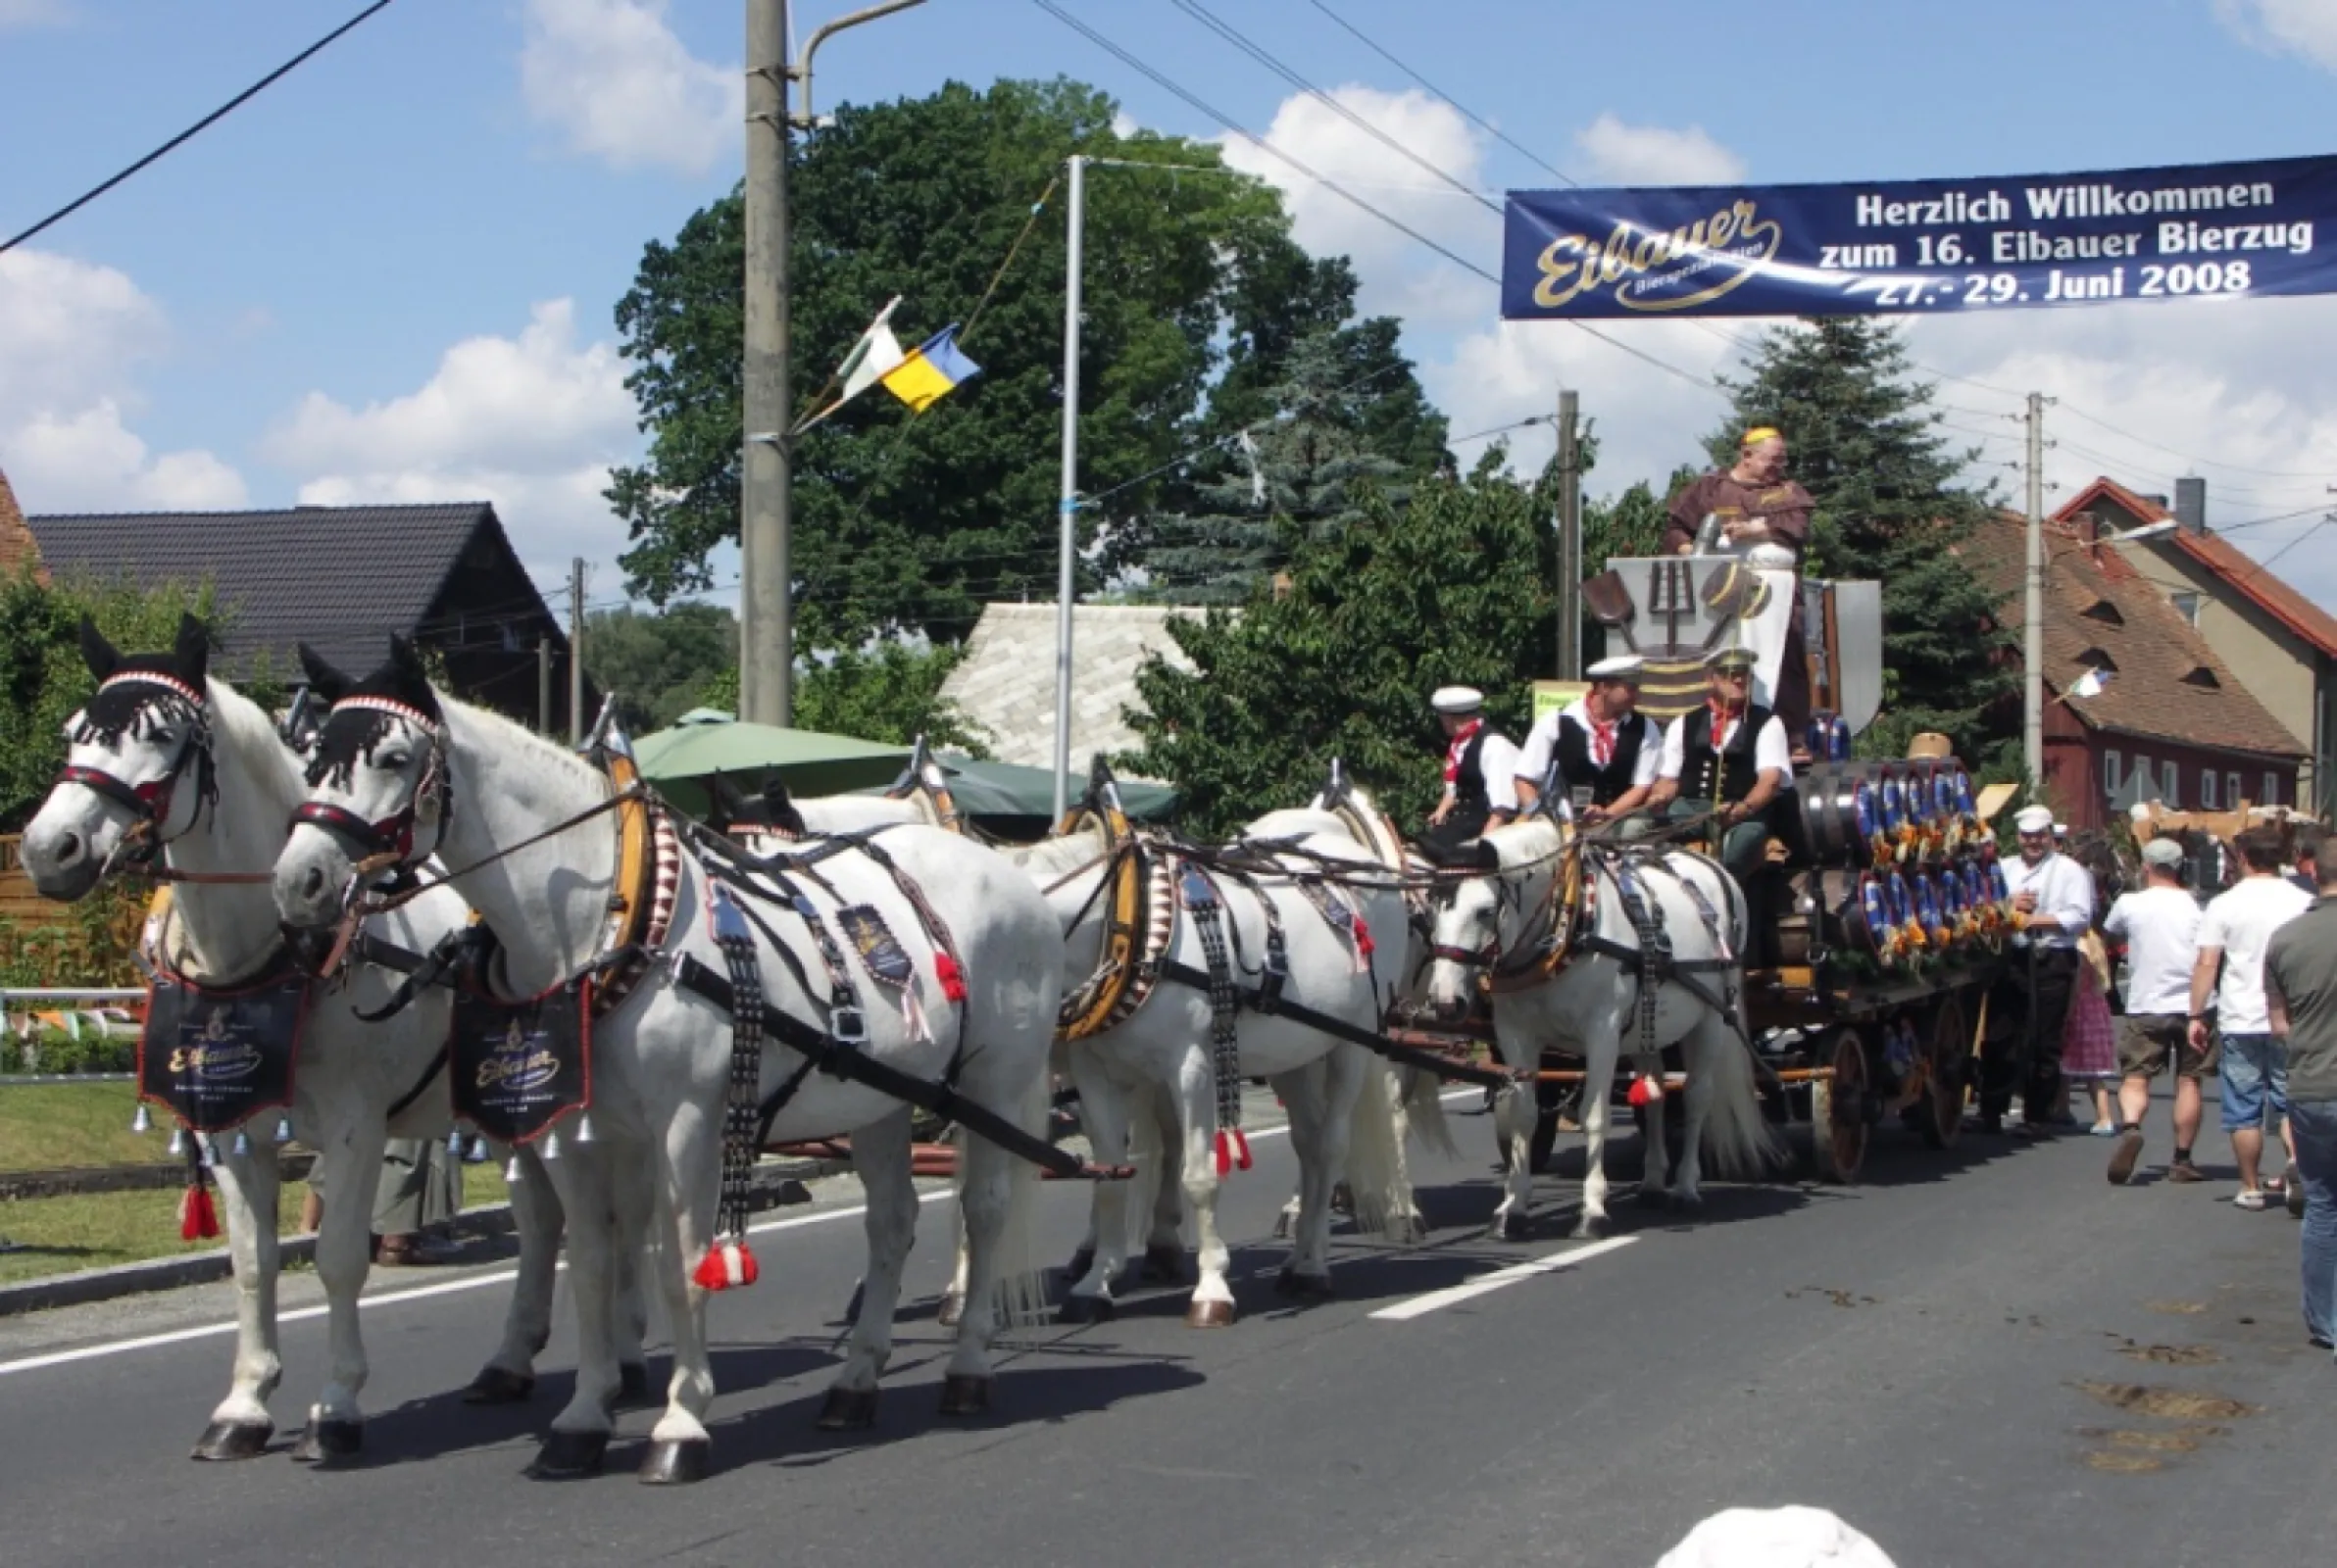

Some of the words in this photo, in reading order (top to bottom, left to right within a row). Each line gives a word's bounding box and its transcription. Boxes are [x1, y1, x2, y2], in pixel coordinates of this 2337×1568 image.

[1856, 190, 2011, 226] Herzlich
[2025, 181, 2275, 220] Willkommen
[1534, 199, 1772, 309] Eibauer
[1819, 243, 1897, 268] zum
[1916, 233, 1976, 267] 16.
[1991, 230, 2142, 264] Eibauer
[2158, 220, 2313, 255] Bierzug
[1963, 272, 2030, 303] 29.
[2043, 265, 2125, 302] Juni
[2138, 259, 2252, 296] 2008
